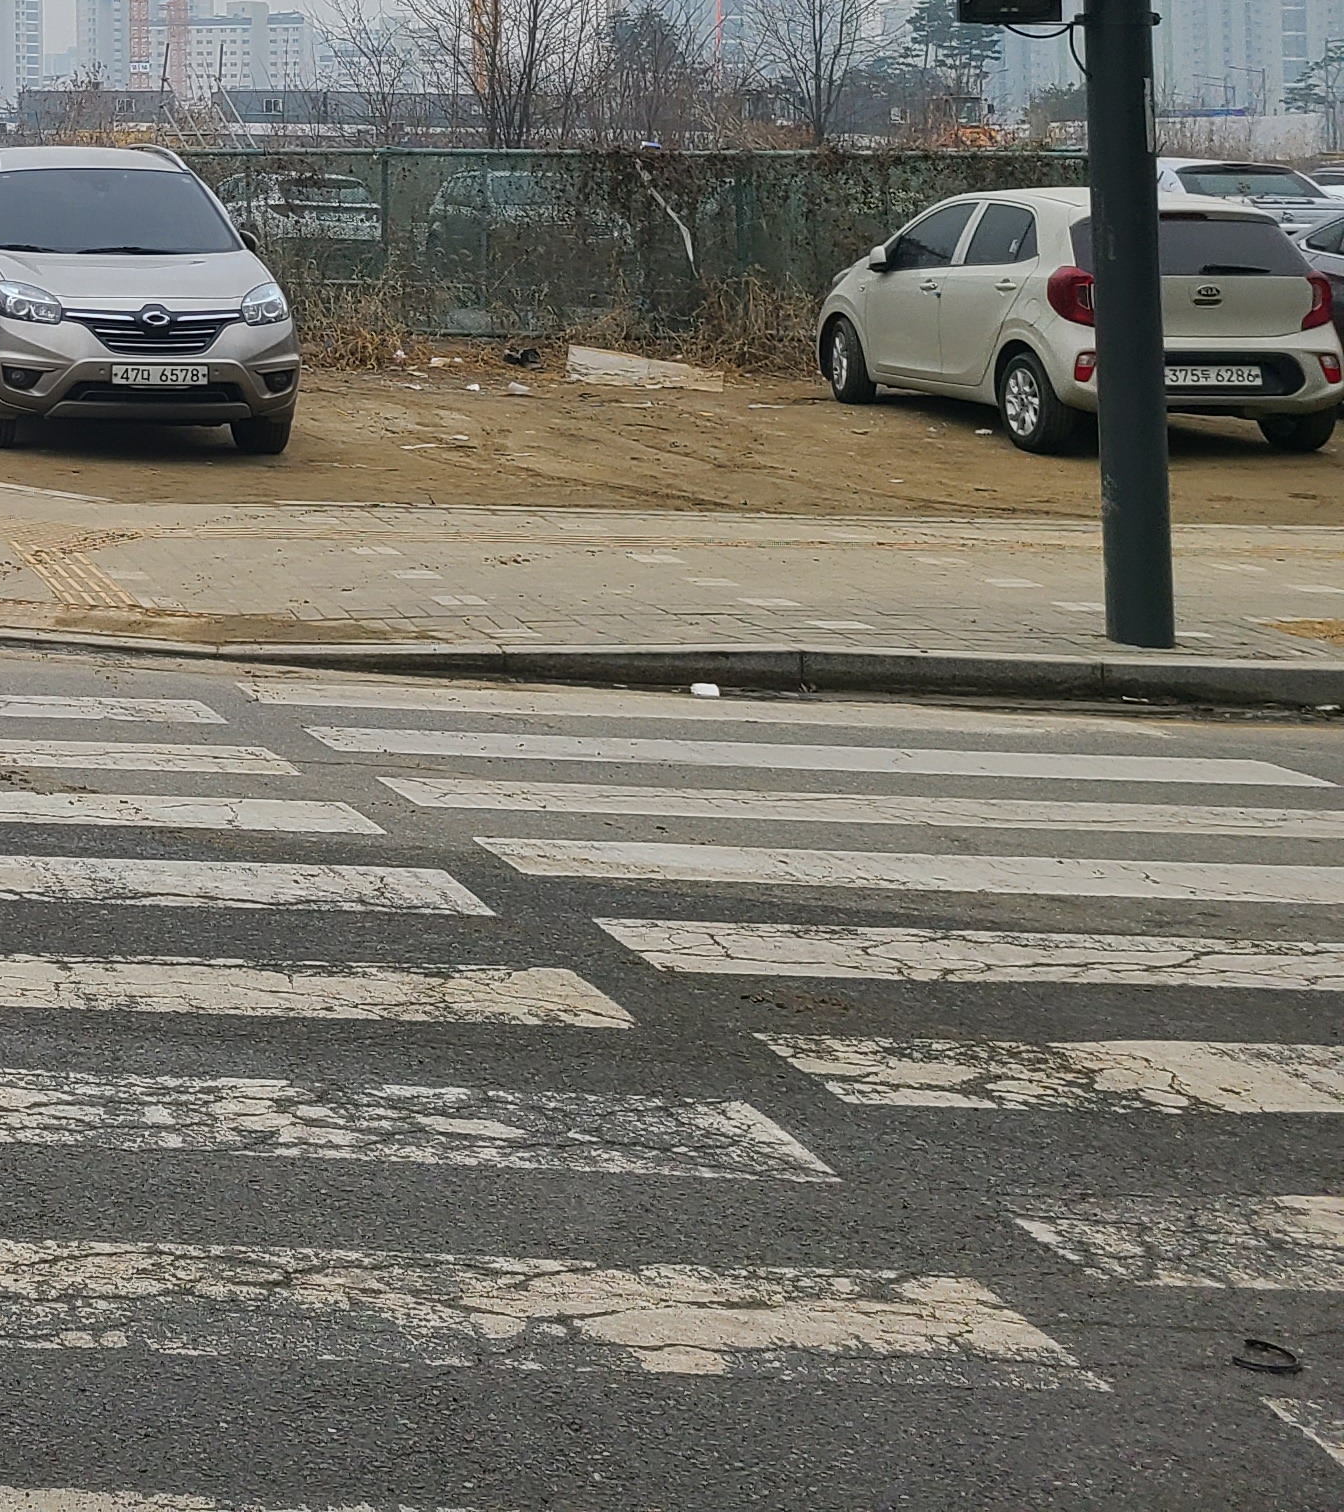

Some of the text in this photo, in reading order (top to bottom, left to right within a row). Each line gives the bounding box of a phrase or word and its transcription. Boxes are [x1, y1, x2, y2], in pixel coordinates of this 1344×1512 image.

[120, 368, 200, 383] 47마 6578
[1169, 369, 1256, 383] 375두 6286
